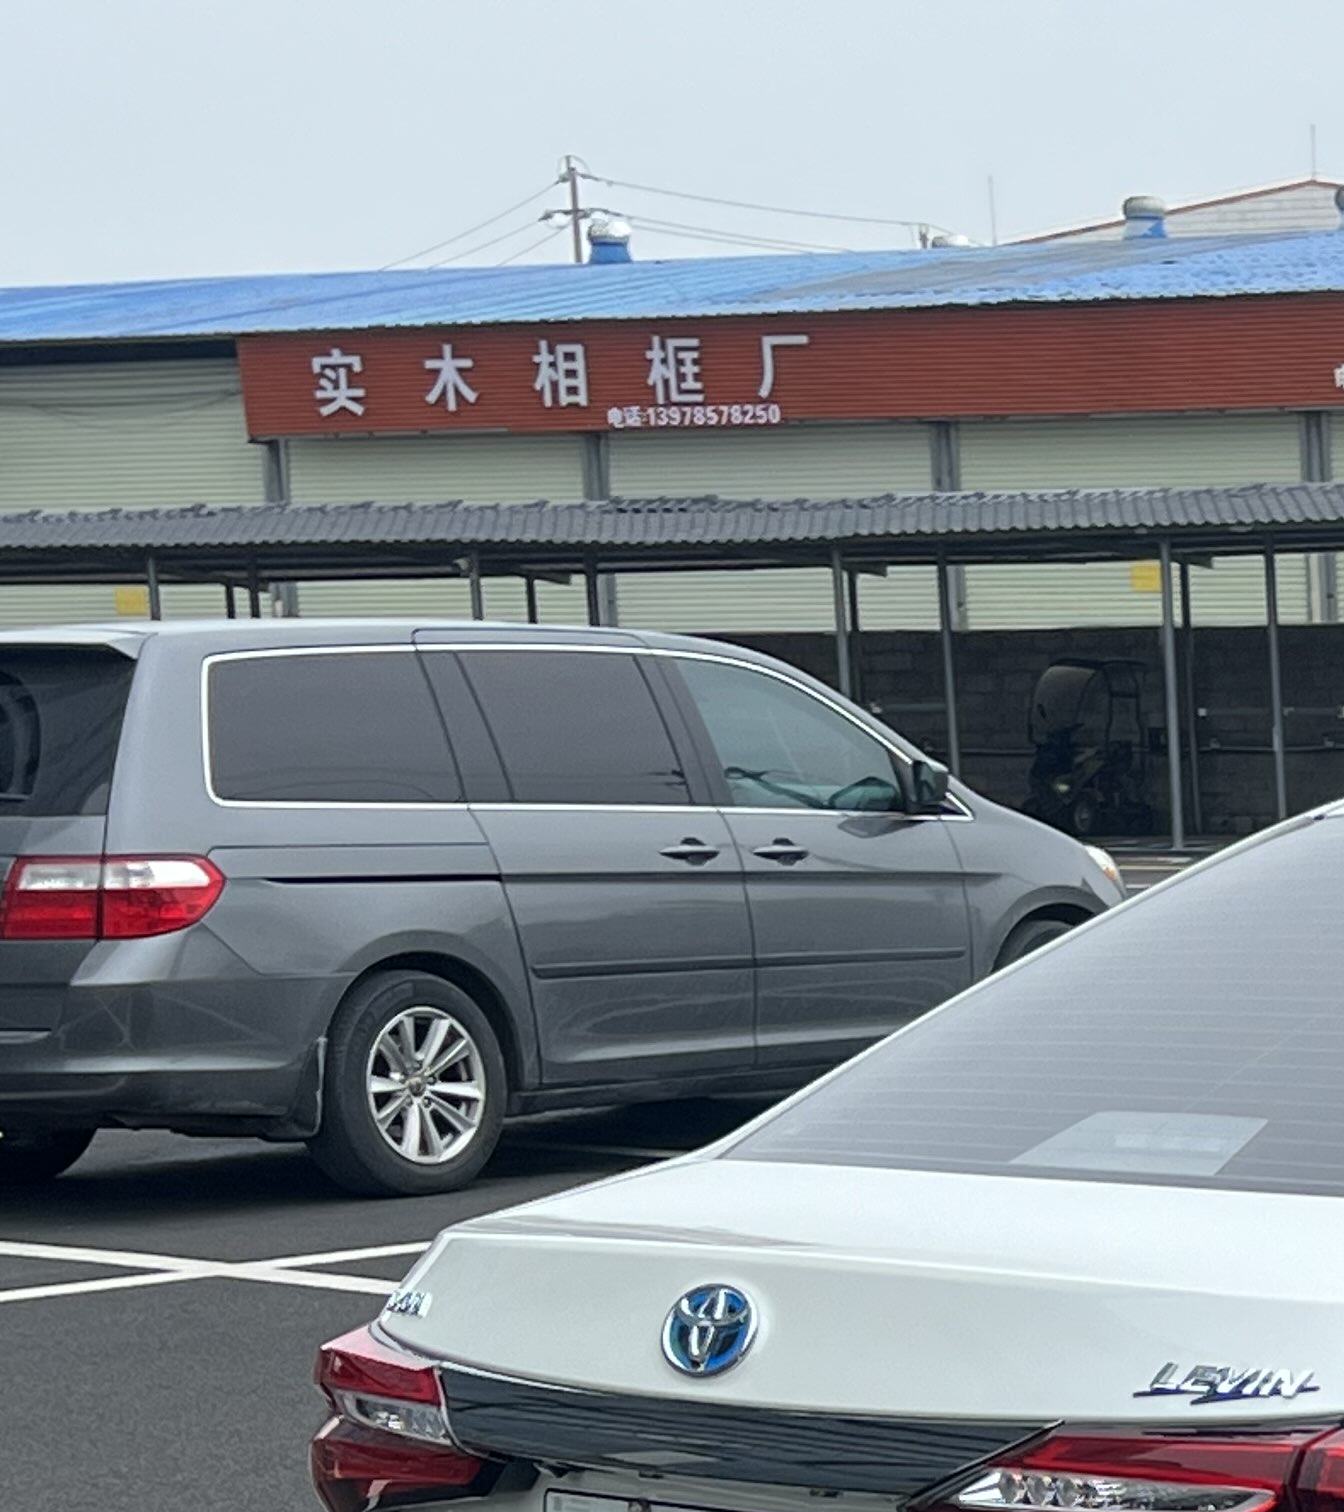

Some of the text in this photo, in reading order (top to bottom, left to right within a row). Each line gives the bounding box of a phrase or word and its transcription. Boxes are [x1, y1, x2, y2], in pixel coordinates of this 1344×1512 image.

[310, 333, 811, 417] 实木相框厂
[1149, 1361, 1317, 1400] LEVIN
